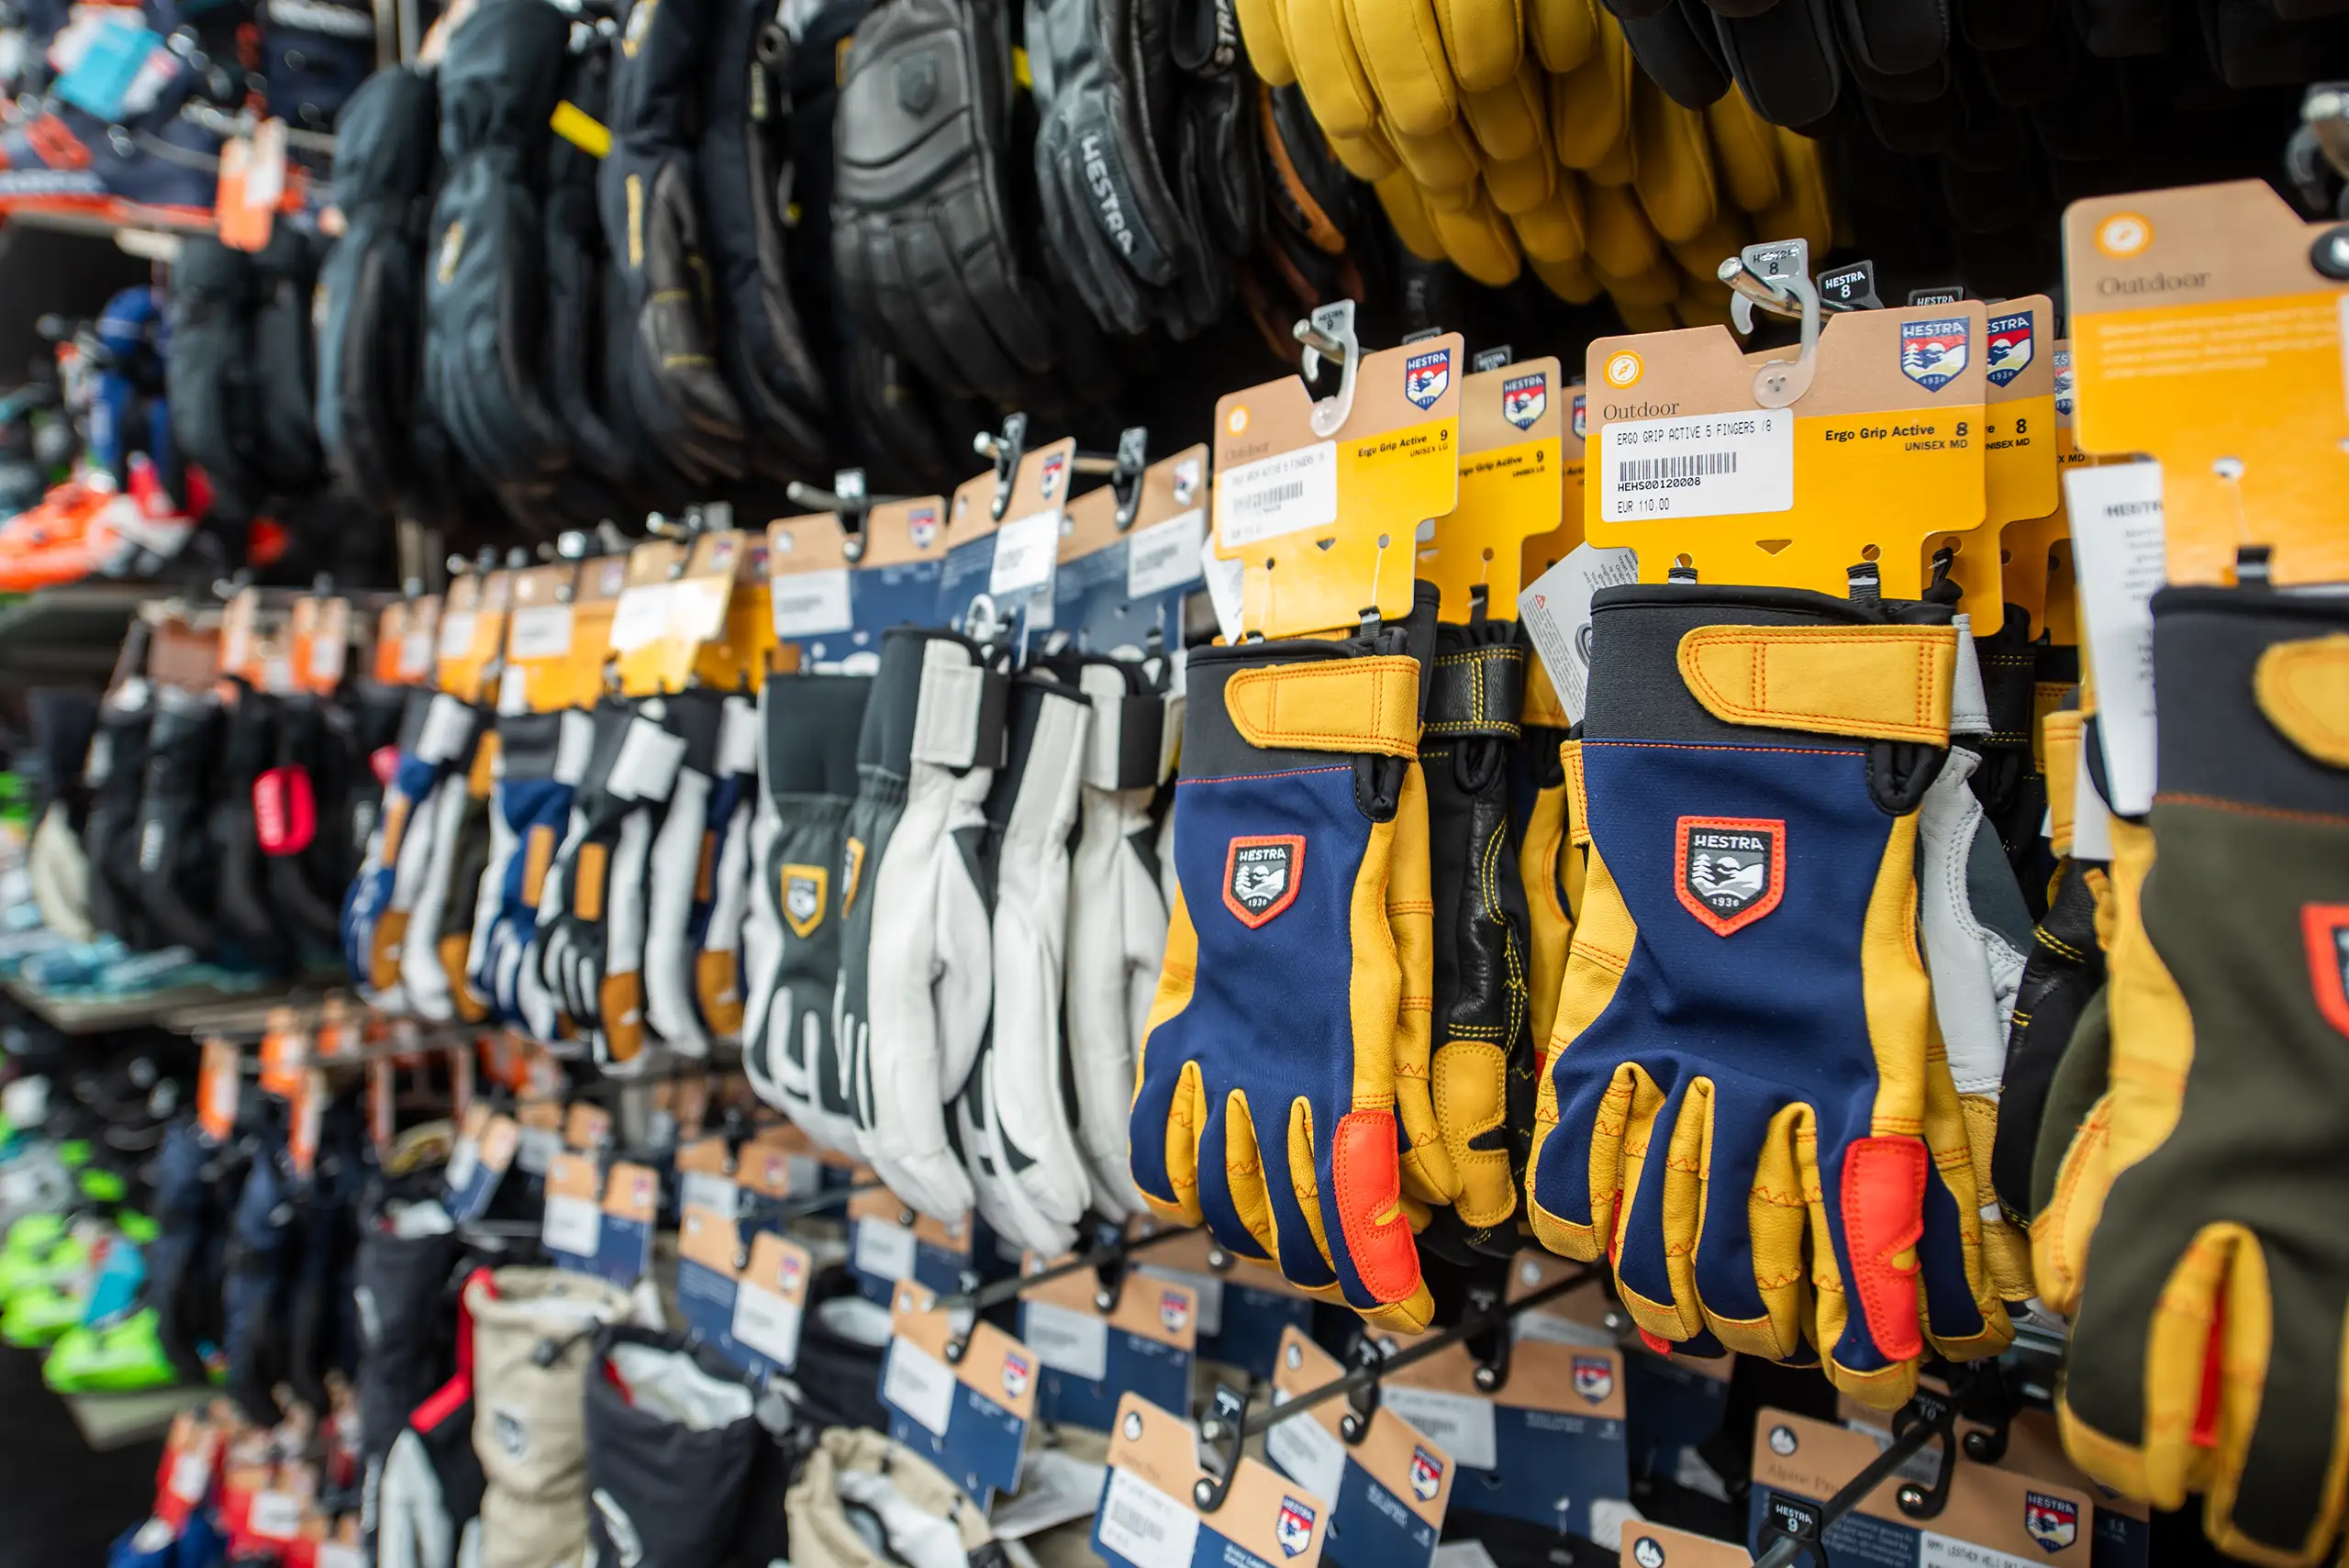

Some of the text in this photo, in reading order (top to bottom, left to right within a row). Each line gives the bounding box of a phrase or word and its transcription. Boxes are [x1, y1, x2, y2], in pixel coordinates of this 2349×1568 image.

[1081, 135, 1134, 256] HESTRA
[1769, 262, 1779, 275] 8
[1825, 271, 1866, 290] HESTRA
[2098, 272, 2212, 298] Outdoor
[1841, 284, 1852, 298] 8
[1917, 295, 1955, 306] HESTRA
[1903, 321, 1965, 338] HESTRA
[1987, 317, 2030, 334] ESTRA
[1408, 352, 1448, 370] HESTRA
[1991, 370, 2014, 381] 1936
[1505, 377, 1544, 392] HESTRA
[1603, 402, 1680, 421] Outdoor
[1617, 432, 1639, 446] ERGO
[1642, 428, 1664, 443] GRIP
[1669, 425, 1701, 442] ACTIVE
[1706, 425, 1712, 438] 5
[1717, 420, 1755, 436] FINGERS
[1825, 421, 1969, 443] Ergo Grip Active 8
[2016, 418, 2028, 434] 8
[1358, 429, 1448, 458] Ergo Grip Active 9
[1409, 442, 1449, 457] UNISEX LG
[1905, 439, 1968, 451] UNISEX MD
[1986, 437, 2031, 450] NISEX MD
[1496, 456, 1523, 468] Active
[1536, 450, 1544, 462] 9
[2067, 454, 2086, 463] MD
[1618, 477, 1701, 493] HEHS00120008
[1618, 497, 1671, 514] EUR 110.00
[2105, 500, 2165, 517] HESTR
[1619, 555, 1628, 572] treat
[1694, 833, 1765, 851] HESTRA
[1239, 847, 1286, 862] HESTRA
[1248, 898, 1268, 907] 1936
[1712, 896, 1740, 907] 1936
[2027, 1494, 2076, 1515] HESTRA
[1776, 1503, 1813, 1526] HESTRA
[1787, 1517, 1799, 1534] 9
